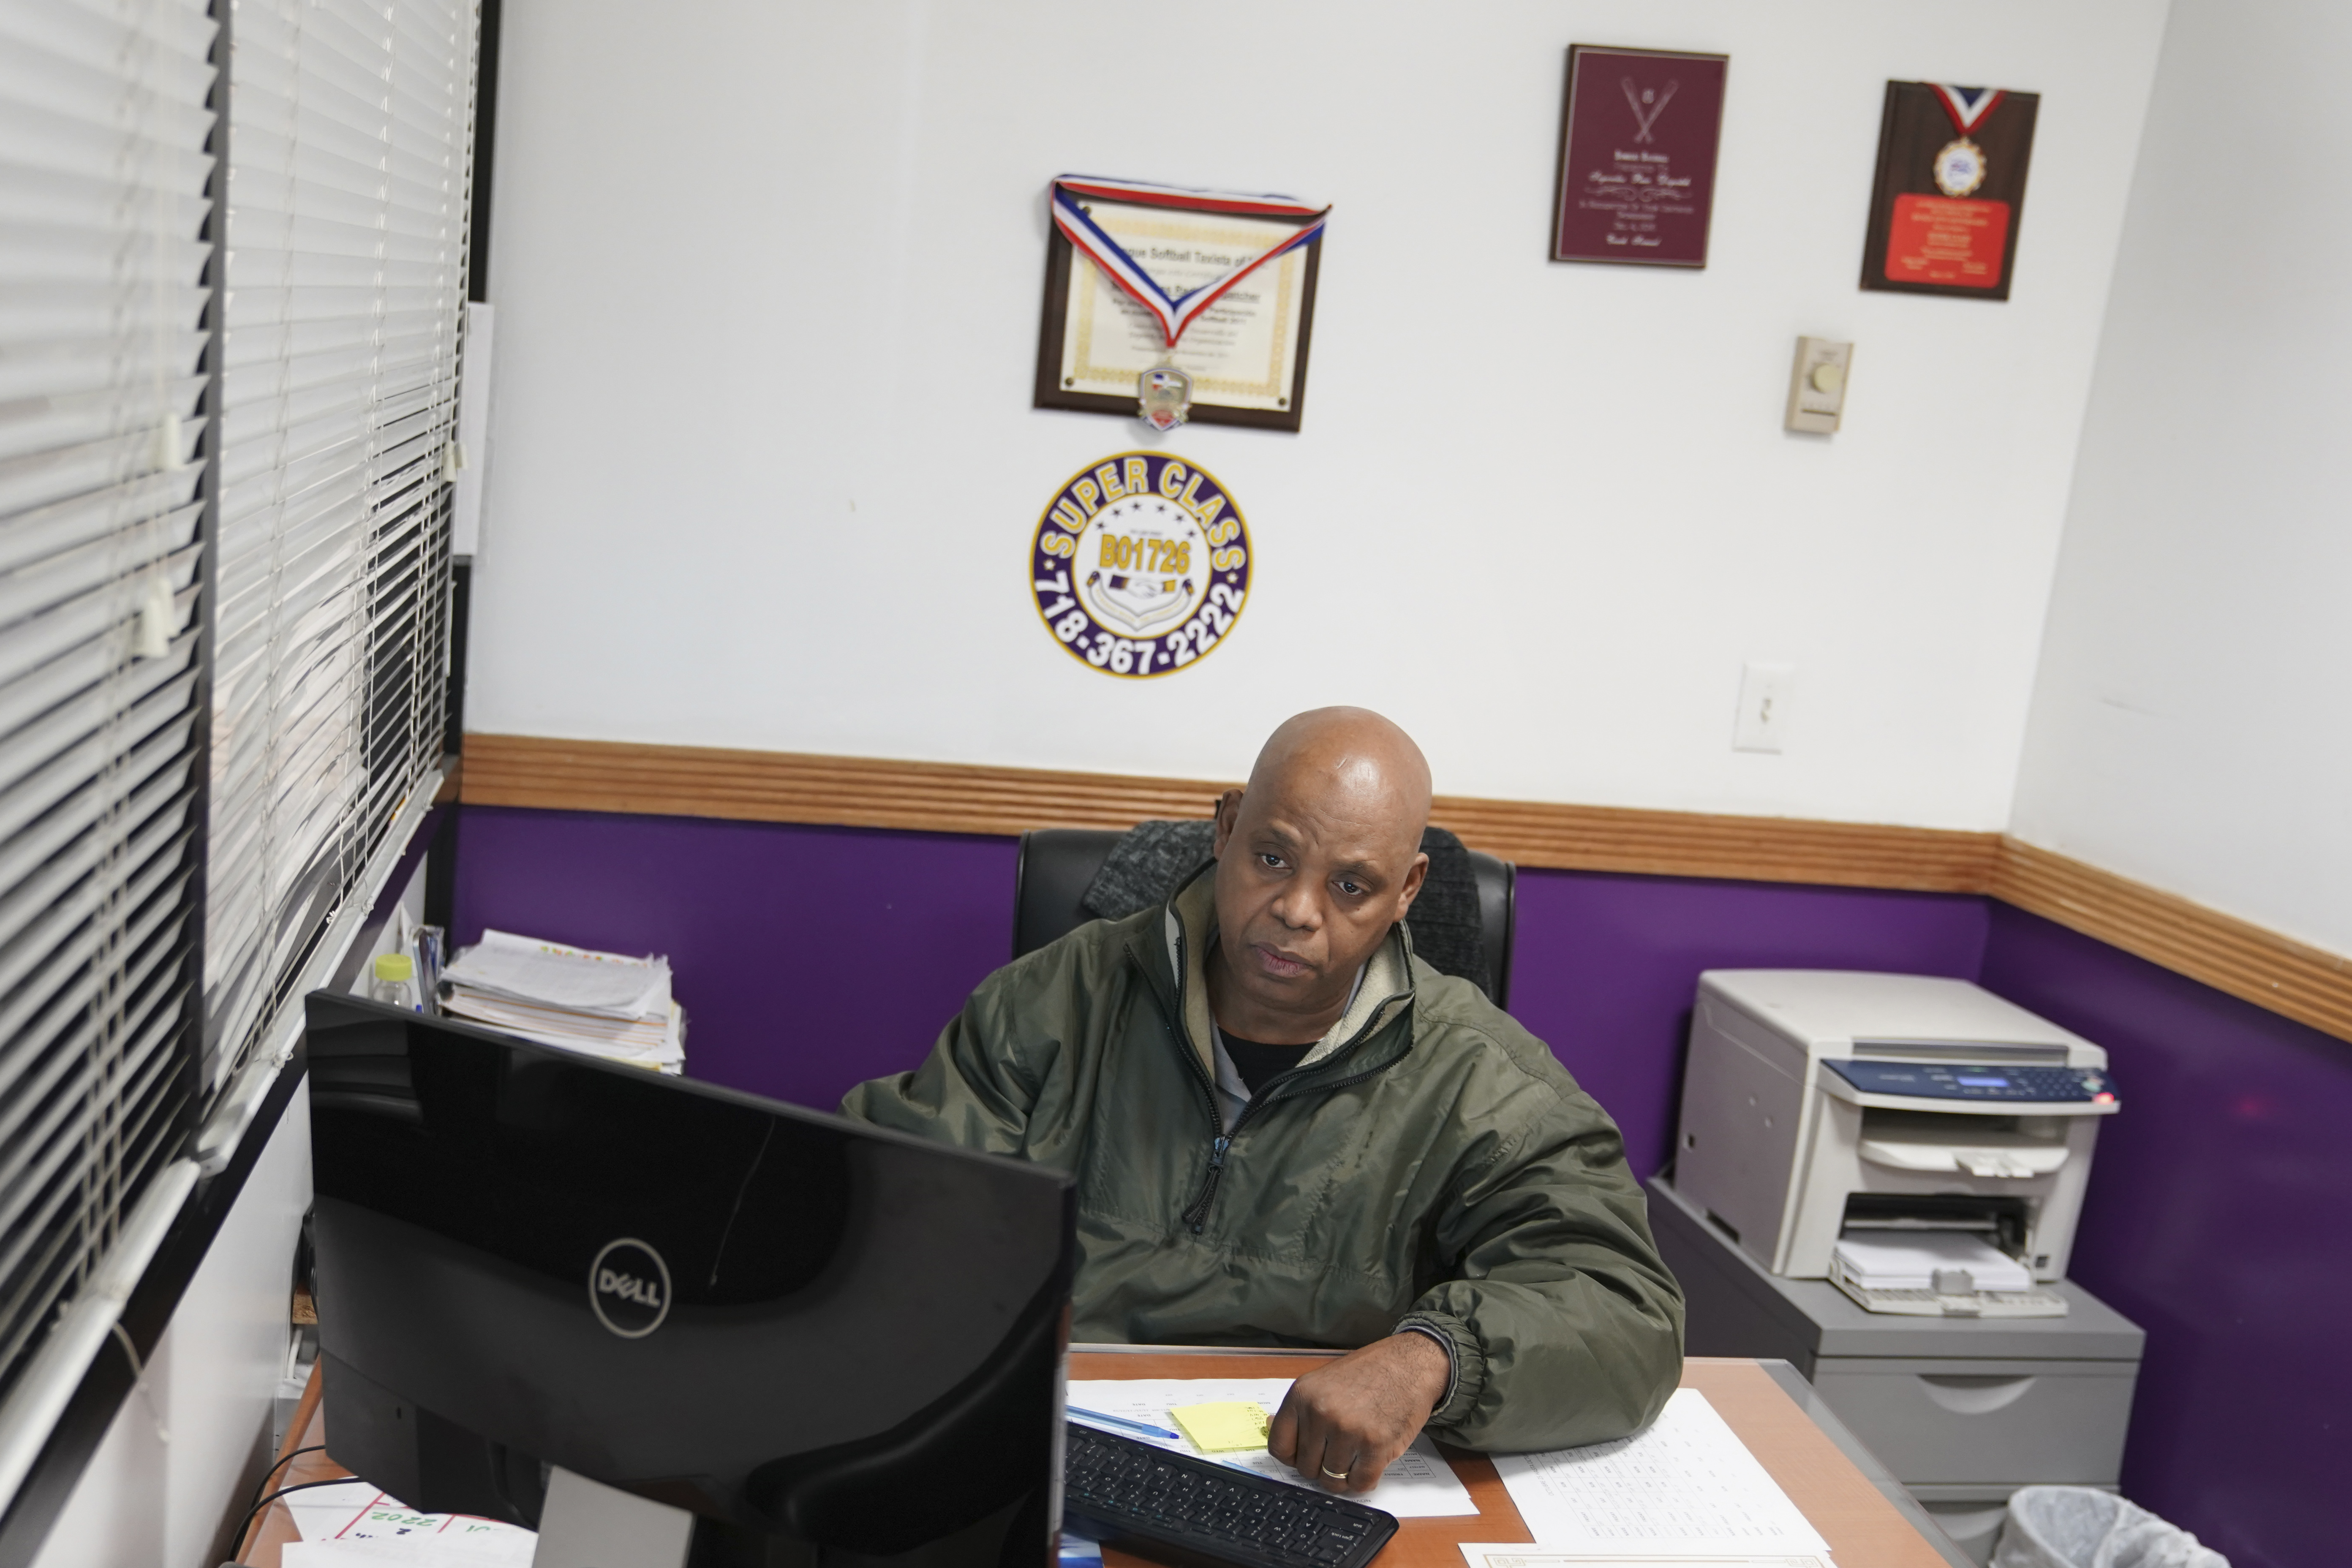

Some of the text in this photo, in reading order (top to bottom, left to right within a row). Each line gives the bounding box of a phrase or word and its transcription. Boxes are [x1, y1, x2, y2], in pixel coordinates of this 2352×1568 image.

[1040, 457, 1246, 572] SUPER CLASS
[598, 1268, 662, 1309] DELL
